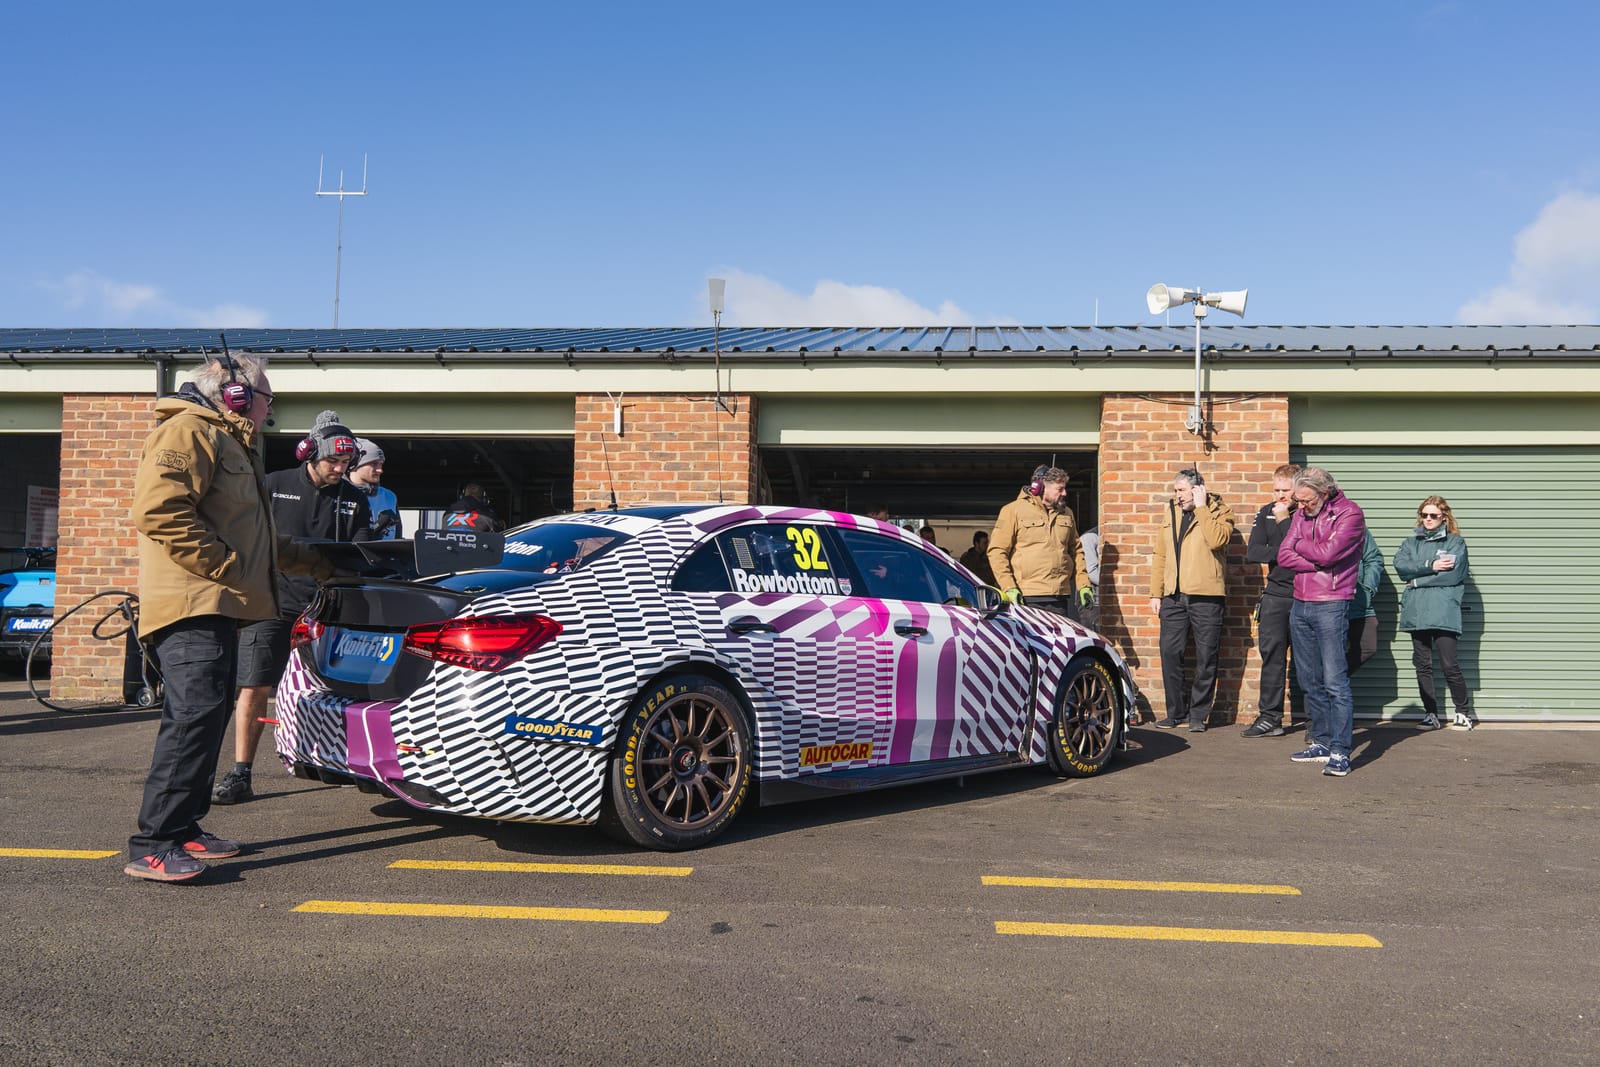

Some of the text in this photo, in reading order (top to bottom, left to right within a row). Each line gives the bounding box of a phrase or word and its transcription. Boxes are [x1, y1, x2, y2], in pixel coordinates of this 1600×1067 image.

[424, 531, 477, 542] PLATO
[786, 527, 828, 570] 32
[732, 568, 838, 595] Rowbottom
[515, 721, 594, 739] GOODYEAR
[804, 743, 869, 765] AUTOCAR
